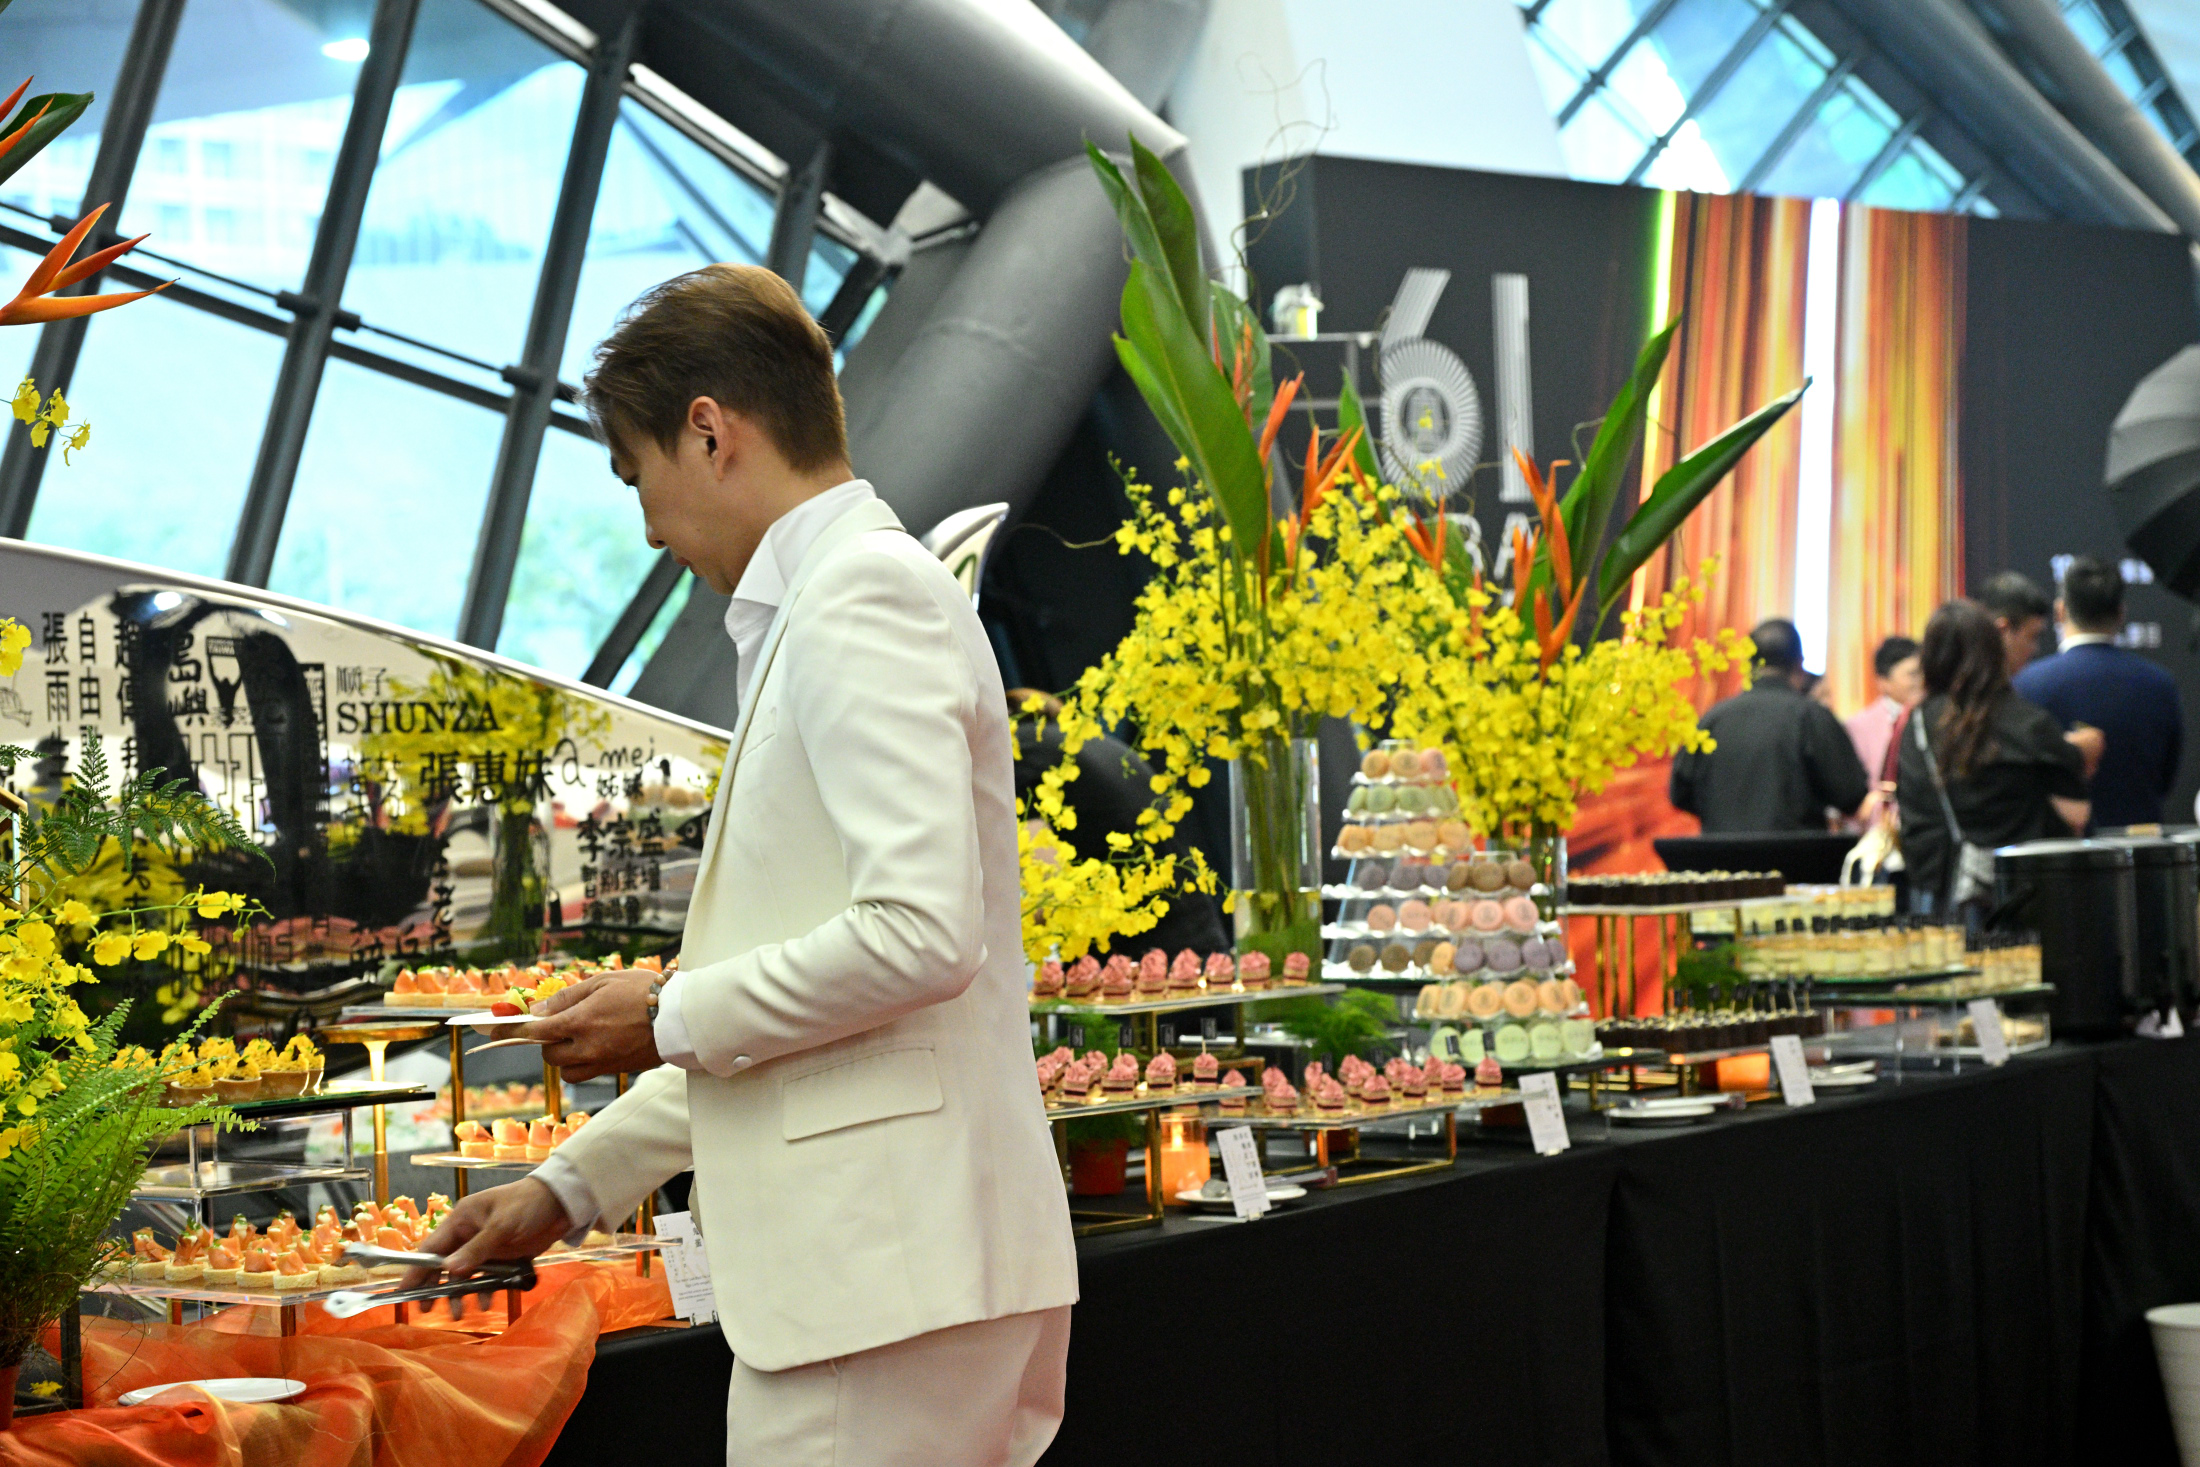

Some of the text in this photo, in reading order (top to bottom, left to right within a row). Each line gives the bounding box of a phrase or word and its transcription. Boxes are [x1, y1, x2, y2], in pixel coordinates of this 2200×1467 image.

[1380, 267, 1536, 502] 61
[42, 612, 72, 777] 張雨生
[337, 702, 502, 733] SHUNZA
[420, 751, 556, 803] 張惠妹
[577, 809, 666, 861] 李宗盛
